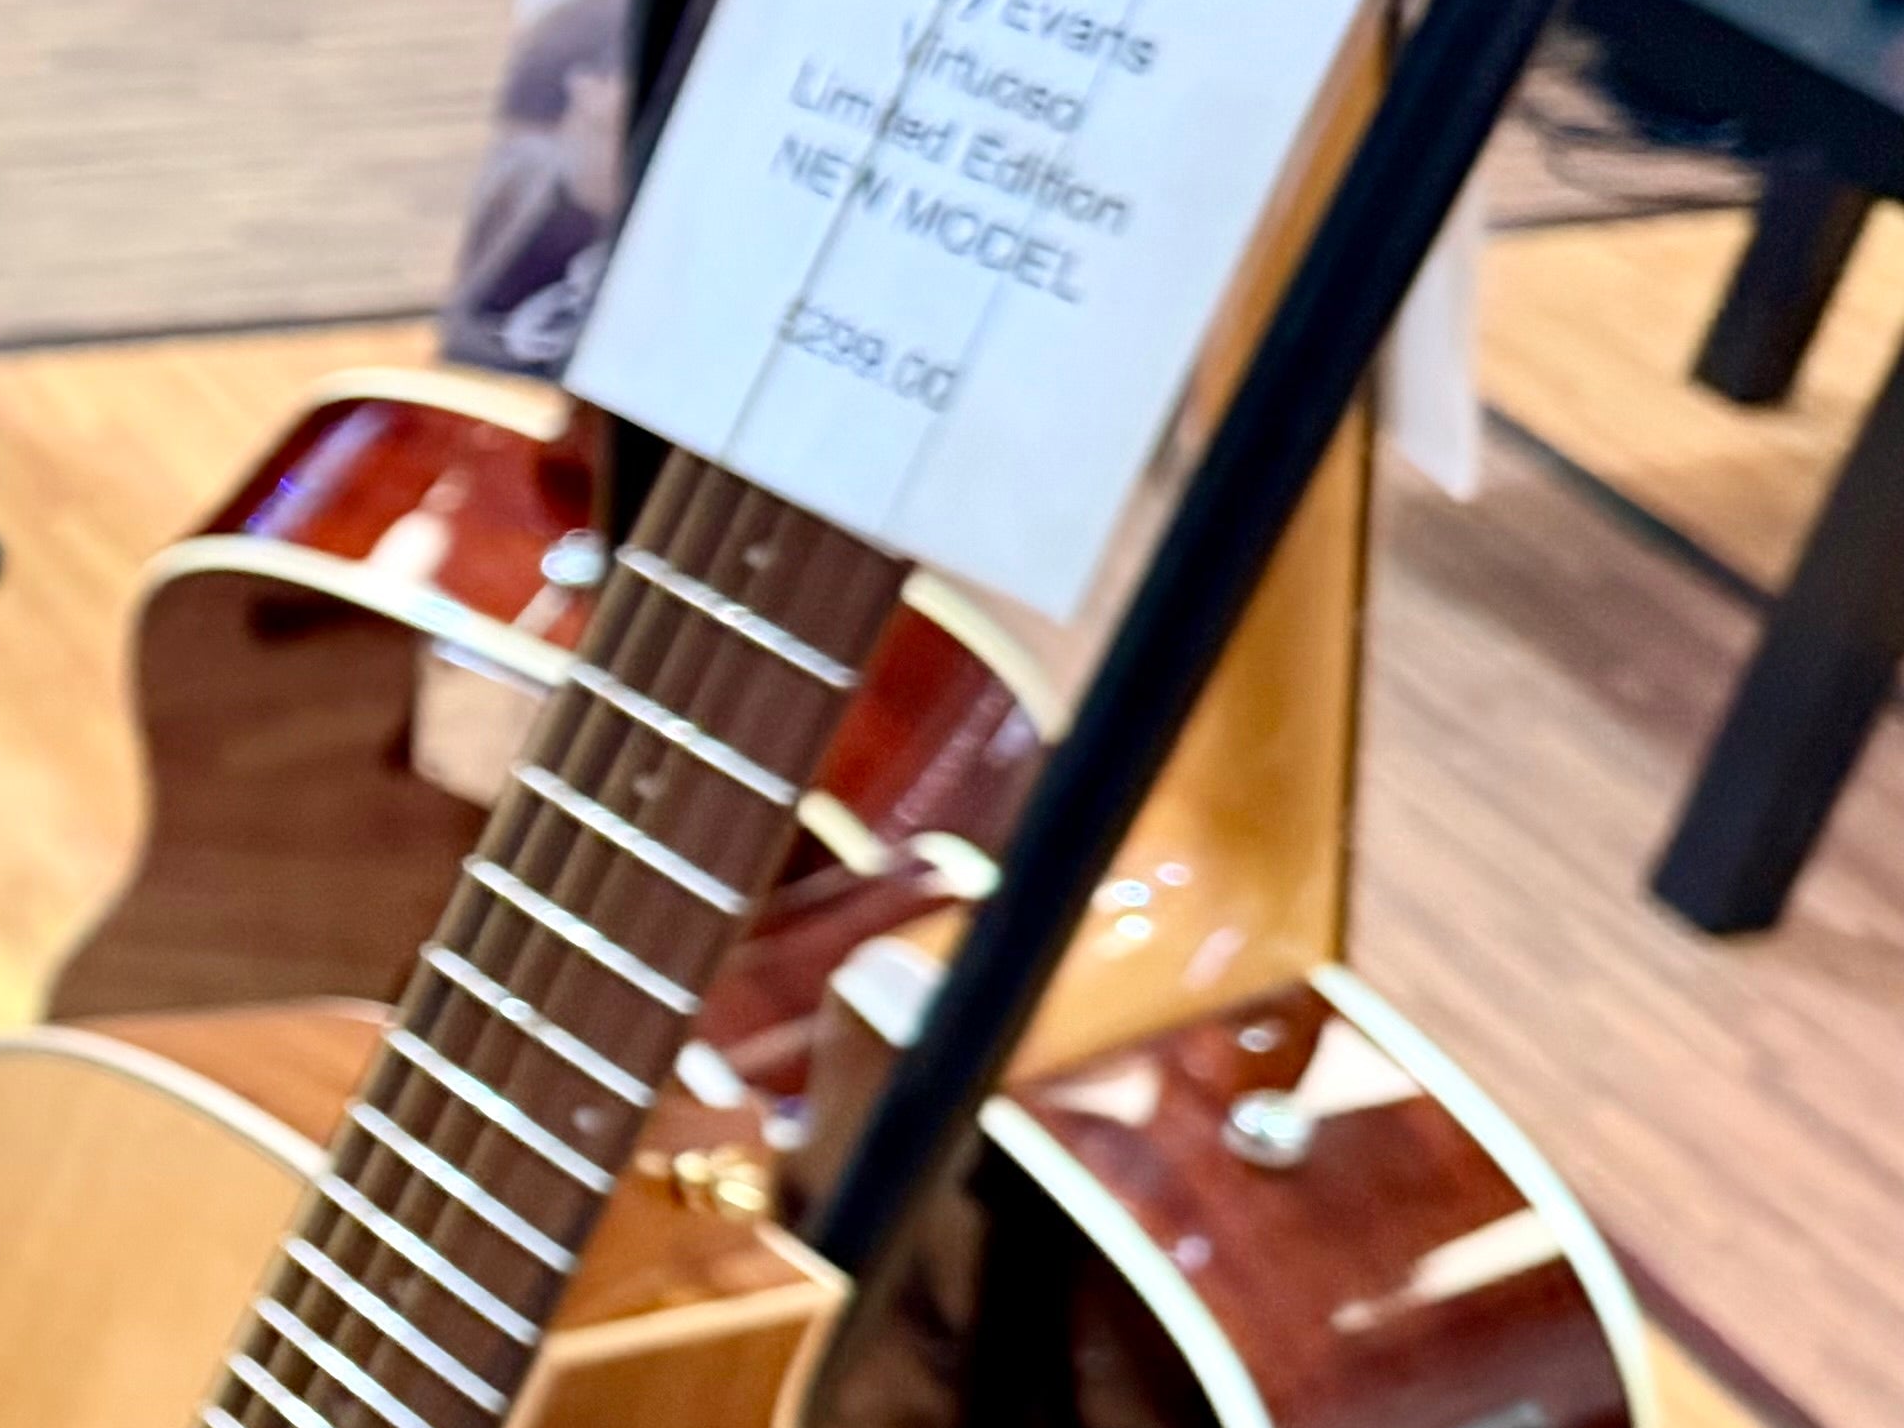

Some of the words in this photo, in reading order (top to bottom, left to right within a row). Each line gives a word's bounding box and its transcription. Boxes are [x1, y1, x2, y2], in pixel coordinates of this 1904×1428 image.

[790, 59, 958, 163] Limed
[962, 133, 1130, 233] Edition
[896, 188, 1082, 304] MODEL
